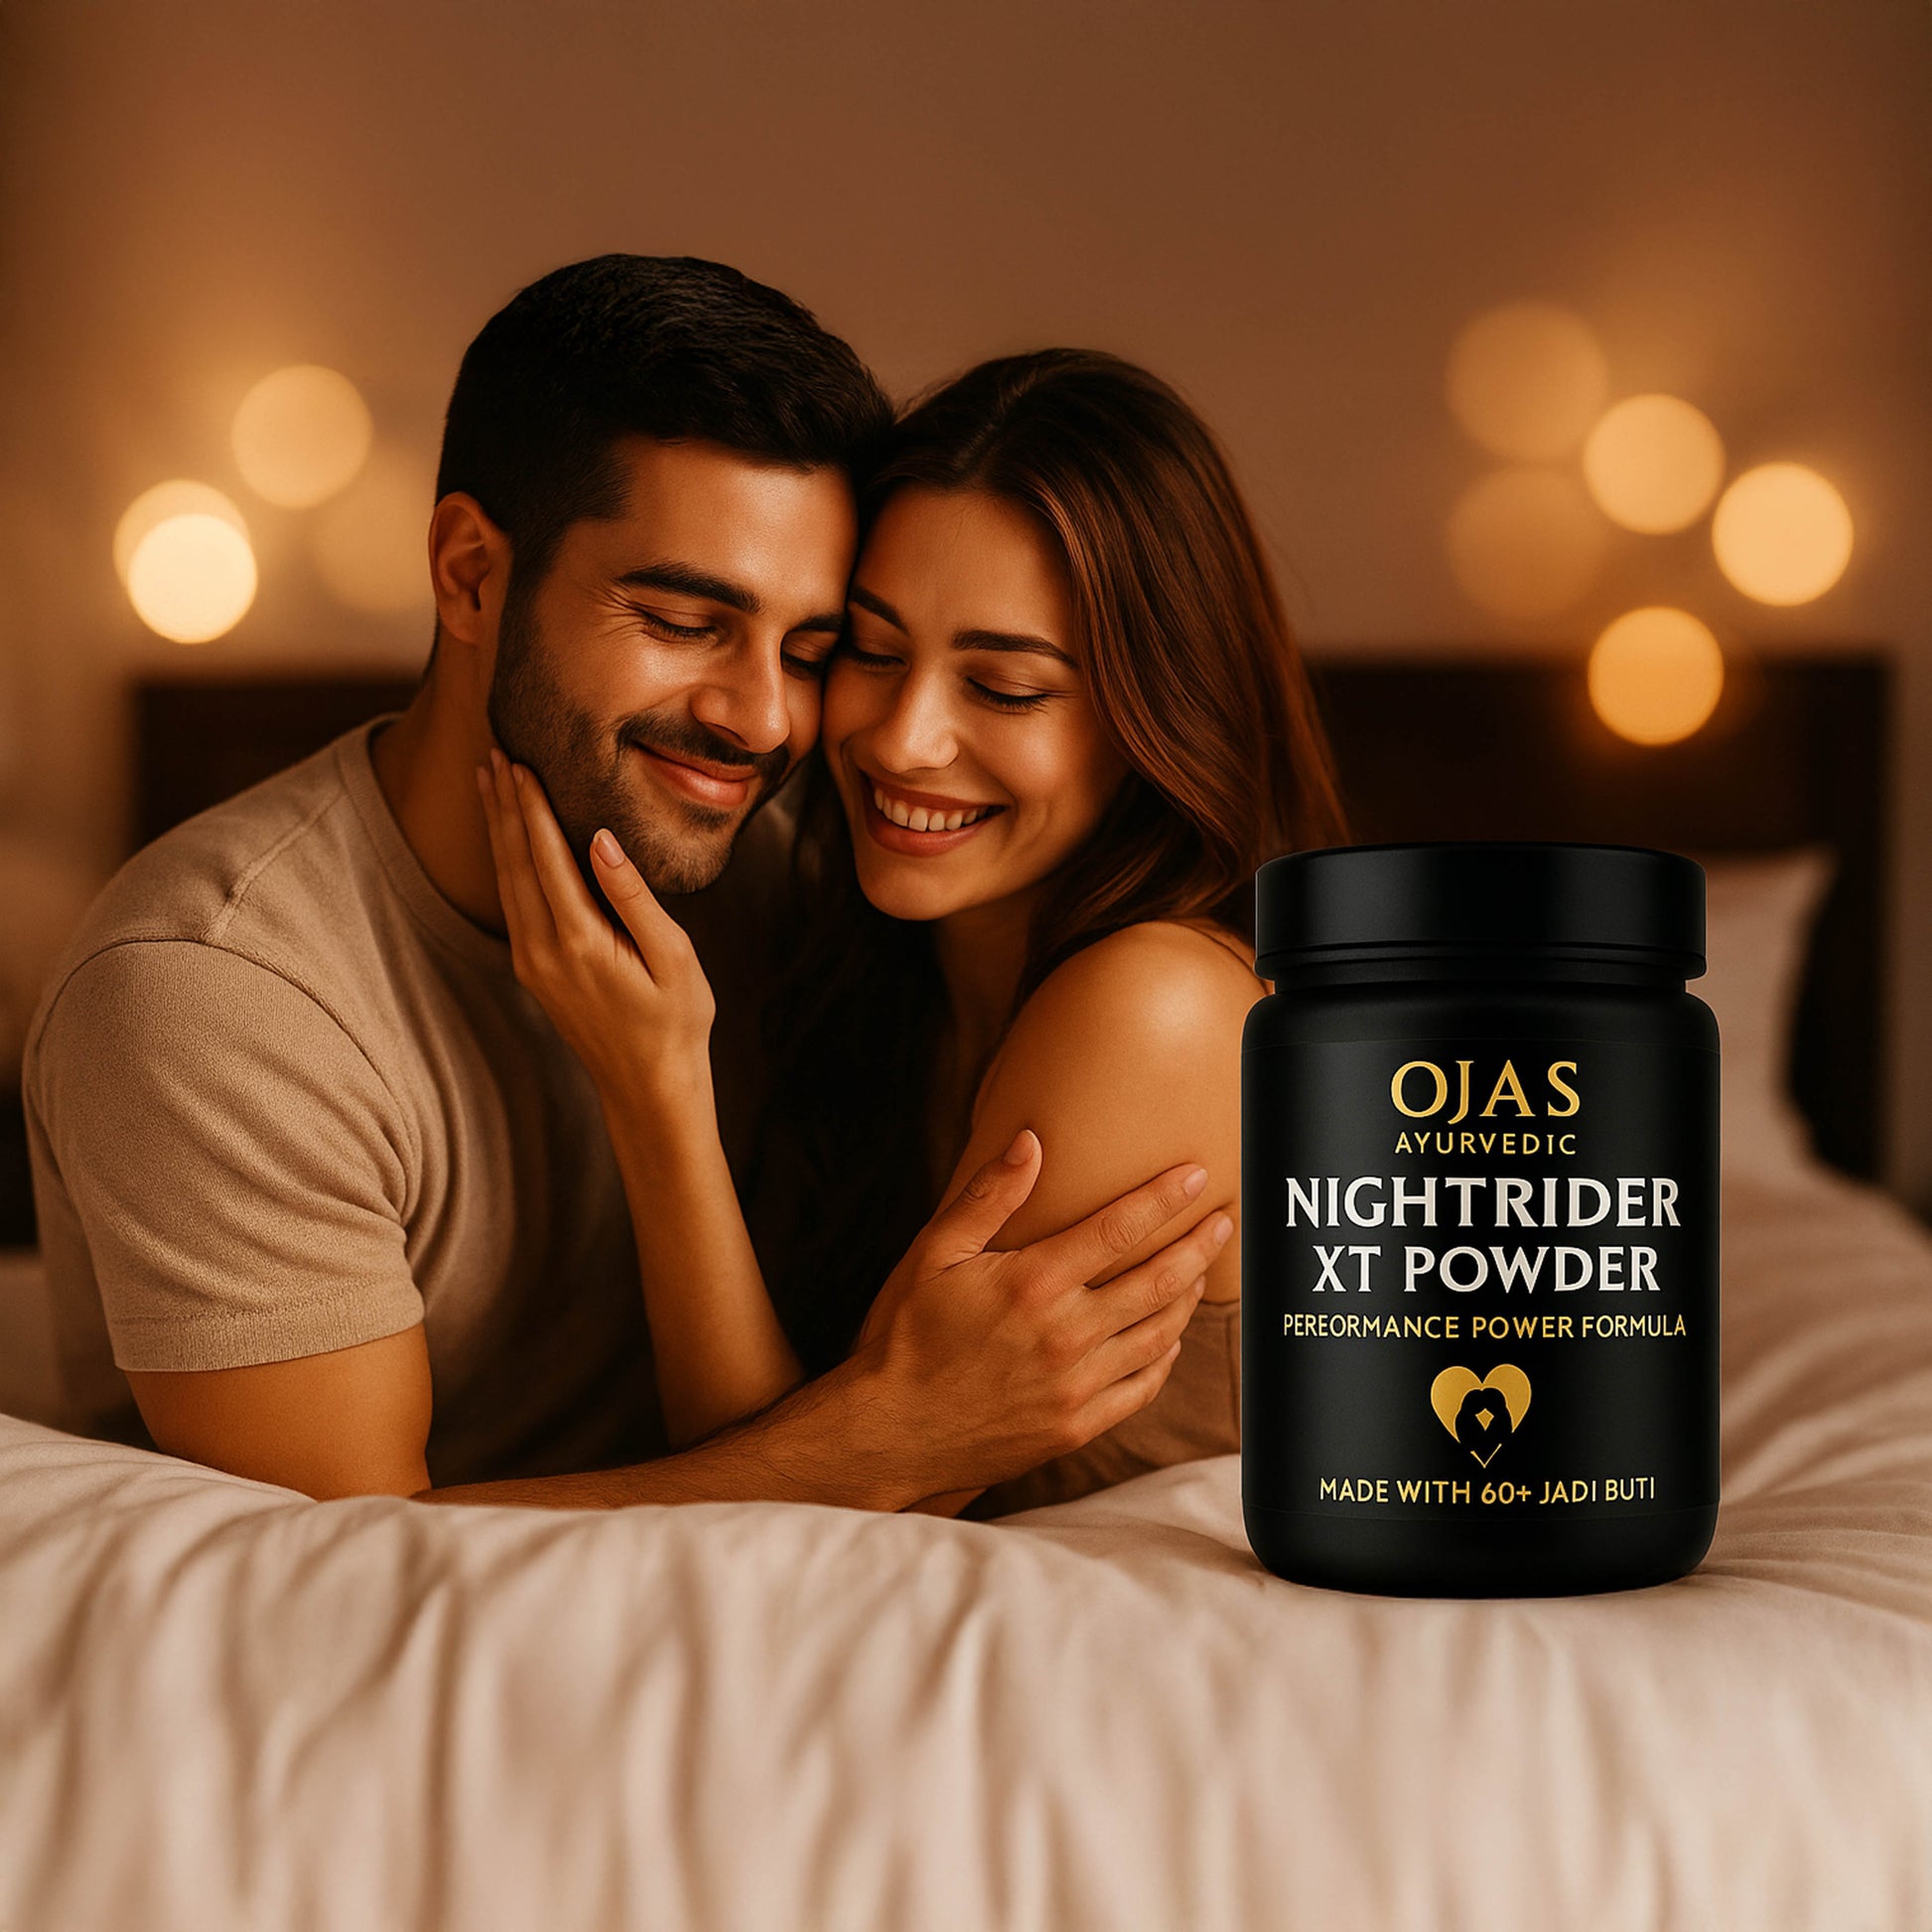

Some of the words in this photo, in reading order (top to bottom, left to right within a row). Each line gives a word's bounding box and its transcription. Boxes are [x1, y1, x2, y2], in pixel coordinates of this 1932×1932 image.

[1390, 1059, 1581, 1125] OJAS
[1394, 1131, 1577, 1156] AYURVEDIC
[1286, 1175, 1682, 1229] NIGHTRIDER
[1311, 1245, 1382, 1293] XT
[1403, 1245, 1661, 1295] POWDER
[1283, 1313, 1459, 1338] PEREORMANCE
[1472, 1315, 1574, 1338] POWER
[1582, 1313, 1687, 1337] FORMULA
[1319, 1476, 1389, 1503] MADE
[1396, 1479, 1470, 1504] WITH
[1480, 1481, 1532, 1504] 60+
[1539, 1479, 1596, 1504] JADI
[1604, 1475, 1655, 1501] BUTI
